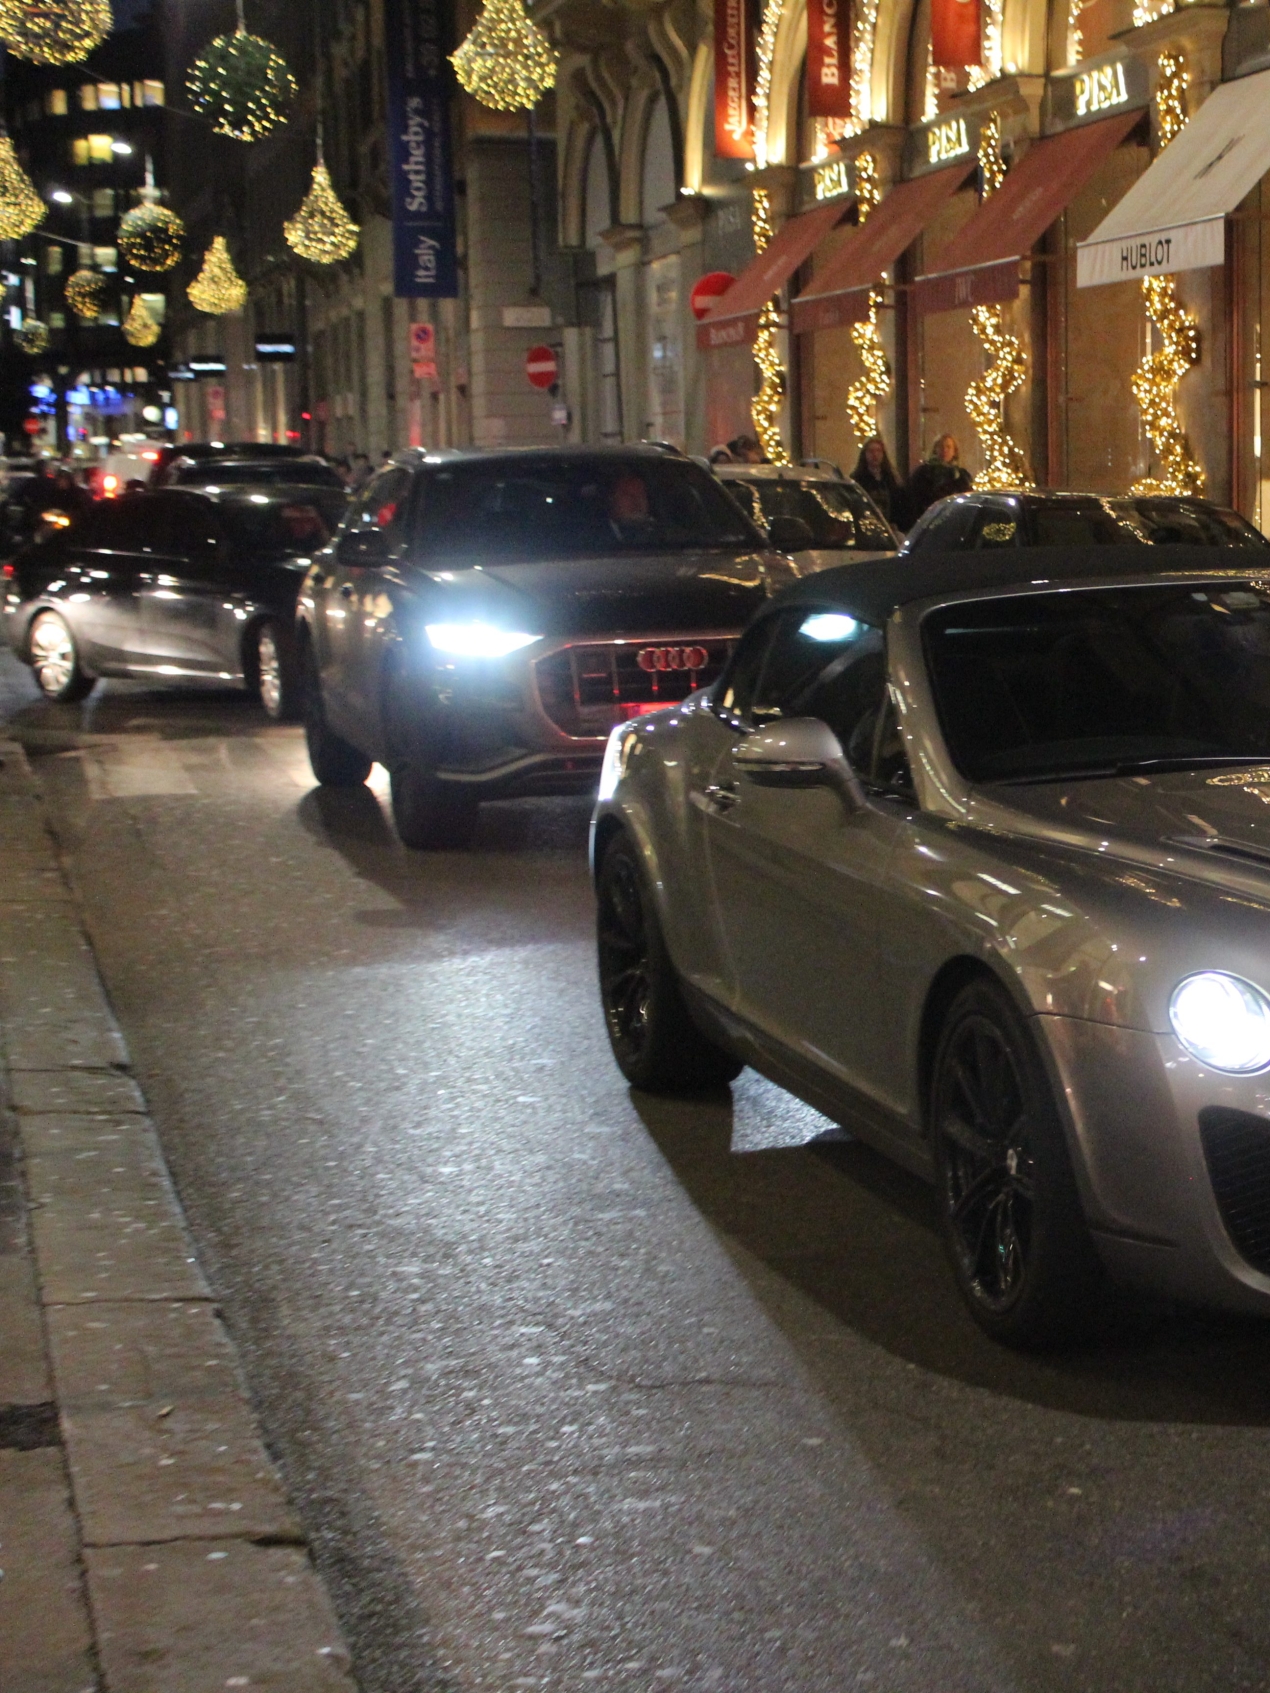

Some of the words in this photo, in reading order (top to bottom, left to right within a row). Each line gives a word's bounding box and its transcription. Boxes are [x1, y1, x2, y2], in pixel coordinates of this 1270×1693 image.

[1075, 61, 1128, 115] PISA
[401, 97, 429, 212] Sotheby's
[928, 117, 969, 163] PISA
[414, 235, 441, 283] Italy
[1121, 239, 1172, 271] HUBLOT
